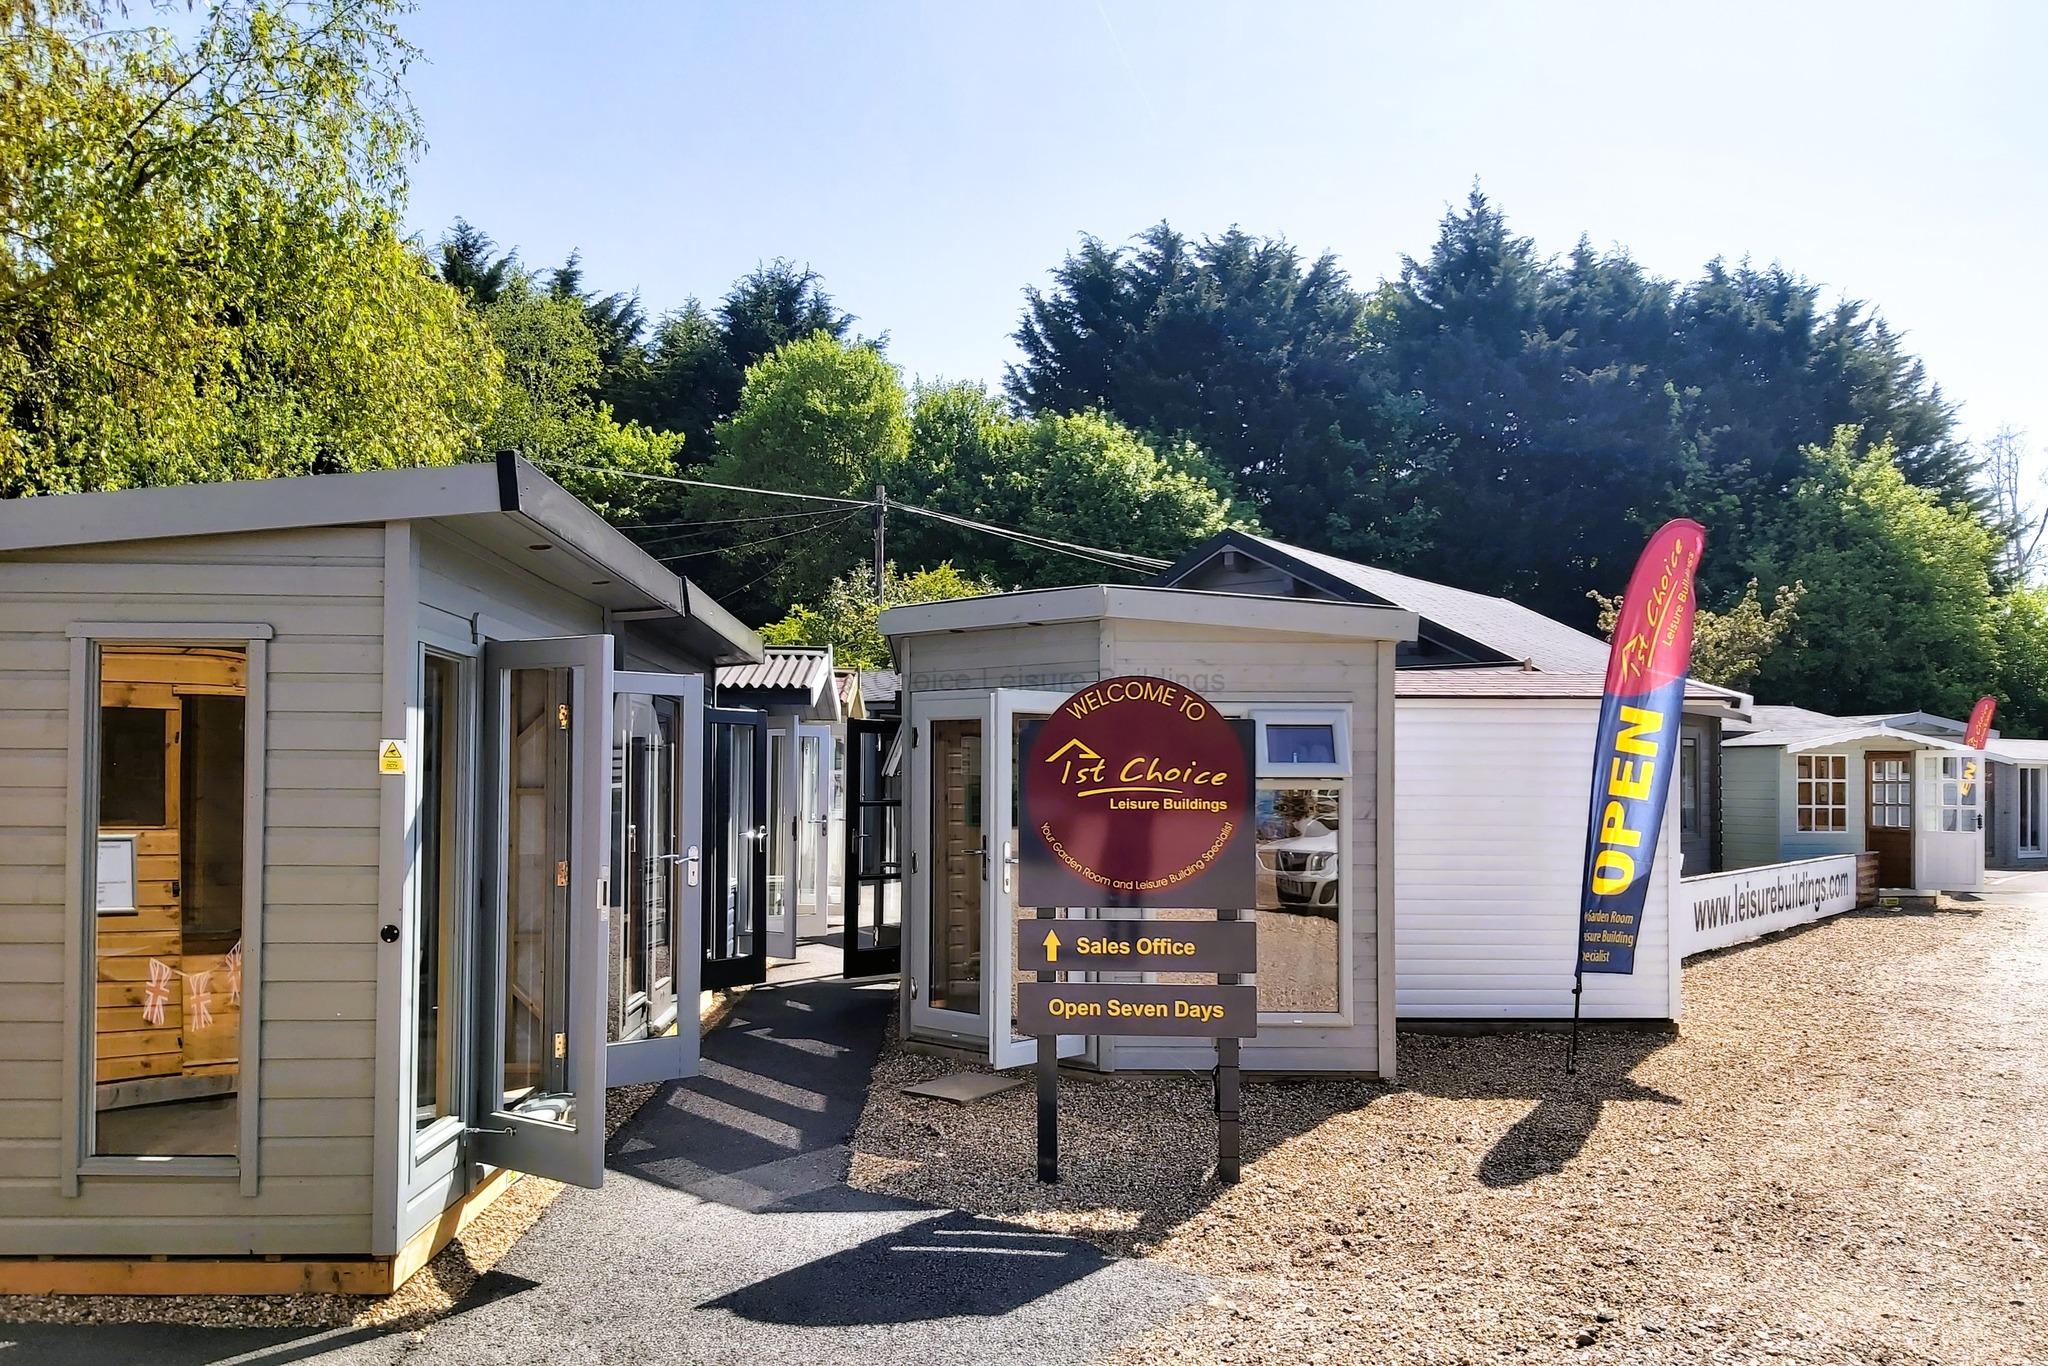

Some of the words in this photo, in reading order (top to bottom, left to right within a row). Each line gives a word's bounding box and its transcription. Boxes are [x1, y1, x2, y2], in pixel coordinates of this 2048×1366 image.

[1646, 538, 1683, 627] Choice
[1662, 604, 1684, 648] Leisure
[1066, 681, 1177, 720] WELCOME
[1179, 694, 1206, 721] TO
[1061, 758, 1105, 784] 1st
[1119, 757, 1228, 786] Choice
[1110, 798, 1160, 811] Leisure
[1163, 798, 1228, 813] Buildings
[1592, 705, 1664, 896] OPEN
[1041, 822, 1056, 843] Your
[1052, 842, 1083, 872] Garden
[1082, 867, 1111, 886] Room
[1112, 880, 1133, 890] and
[1135, 878, 1168, 890] Leisure
[1169, 860, 1205, 883] Building
[1202, 821, 1233, 862] Specialist
[1610, 911, 1634, 924] Room
[1693, 871, 1849, 932] www.leisurebuildings.com
[1076, 937, 1131, 955] Sales
[1136, 938, 1196, 956] Office
[1602, 930, 1634, 947] Building
[1048, 998, 1101, 1019] Open
[1107, 999, 1168, 1017] Seven
[1174, 1000, 1225, 1022] Days
